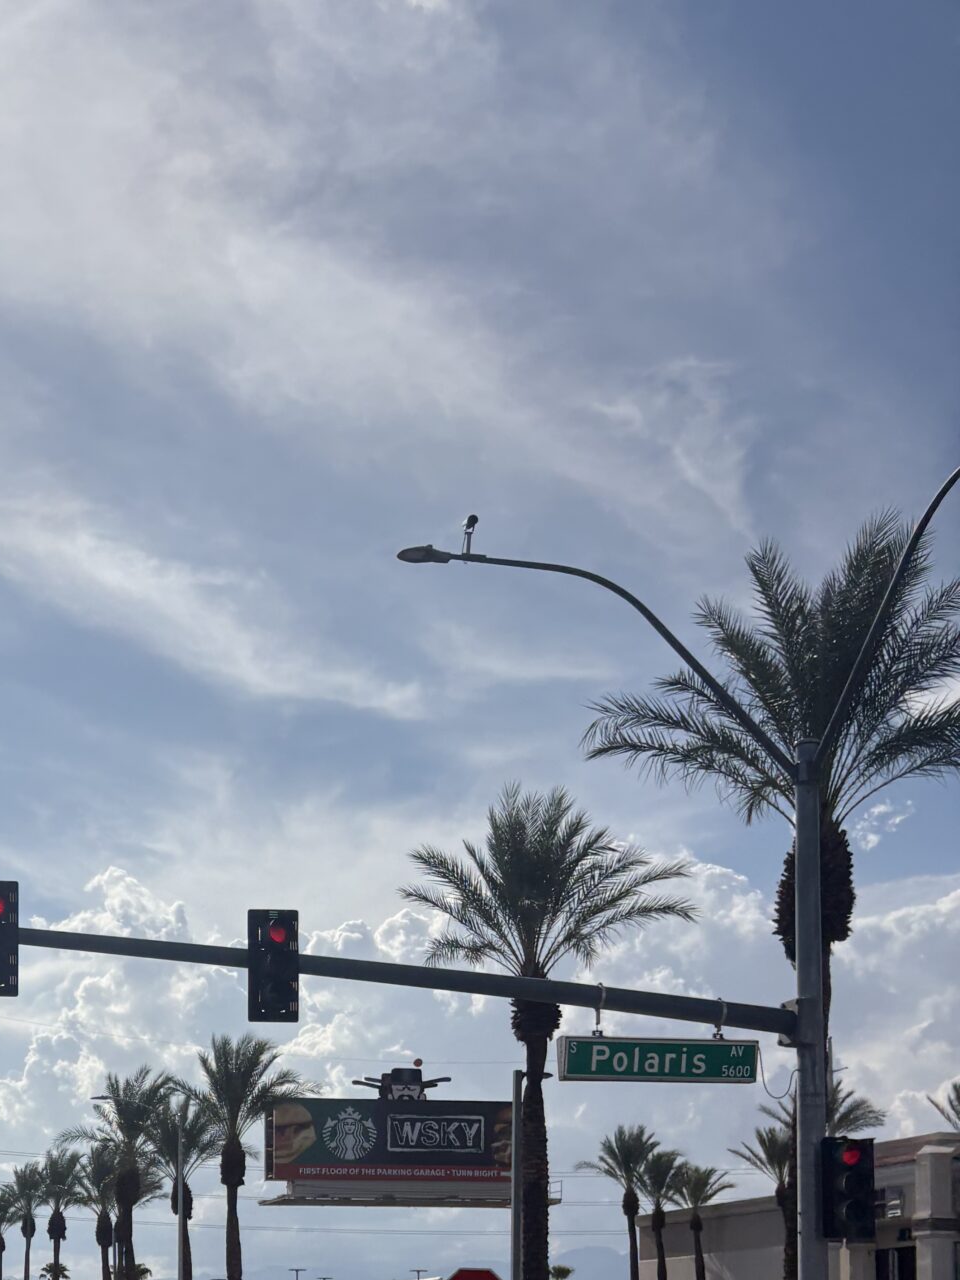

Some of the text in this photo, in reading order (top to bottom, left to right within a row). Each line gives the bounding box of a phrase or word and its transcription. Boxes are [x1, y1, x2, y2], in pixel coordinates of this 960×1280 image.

[570, 1042, 751, 1078] S Polaris AV 5600
[393, 1121, 480, 1146] WSKY
[299, 1167, 498, 1178] FIRST FLOOR OF THE PARKING GARAGE TURN RIGHT
